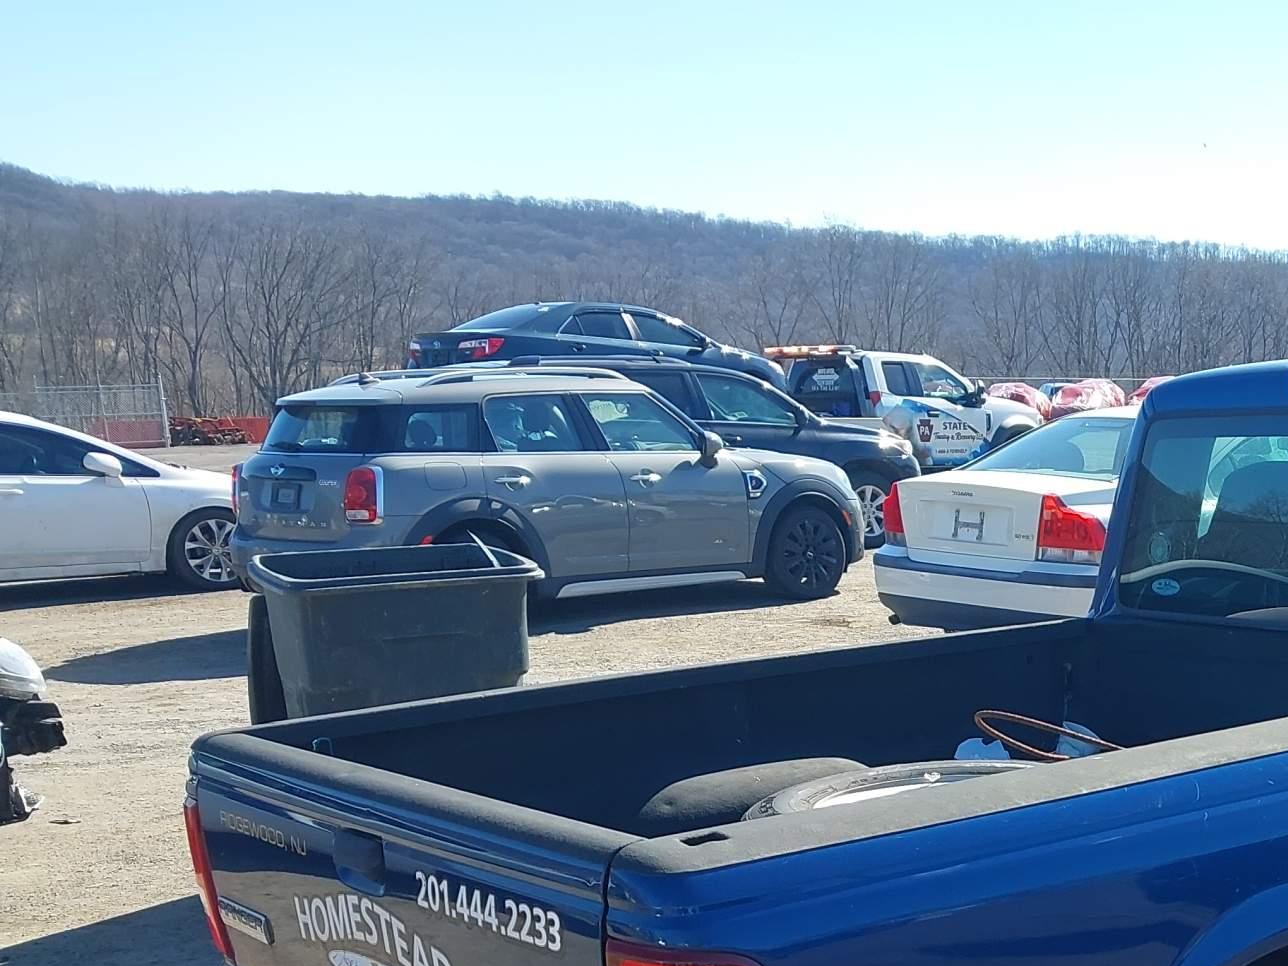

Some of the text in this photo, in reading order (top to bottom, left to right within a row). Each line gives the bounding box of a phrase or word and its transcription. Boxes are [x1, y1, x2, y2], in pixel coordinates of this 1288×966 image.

[919, 425, 930, 436] PA
[942, 421, 968, 431] STATE
[290, 835, 307, 856] NJ
[415, 870, 562, 952] 201.444.2233
